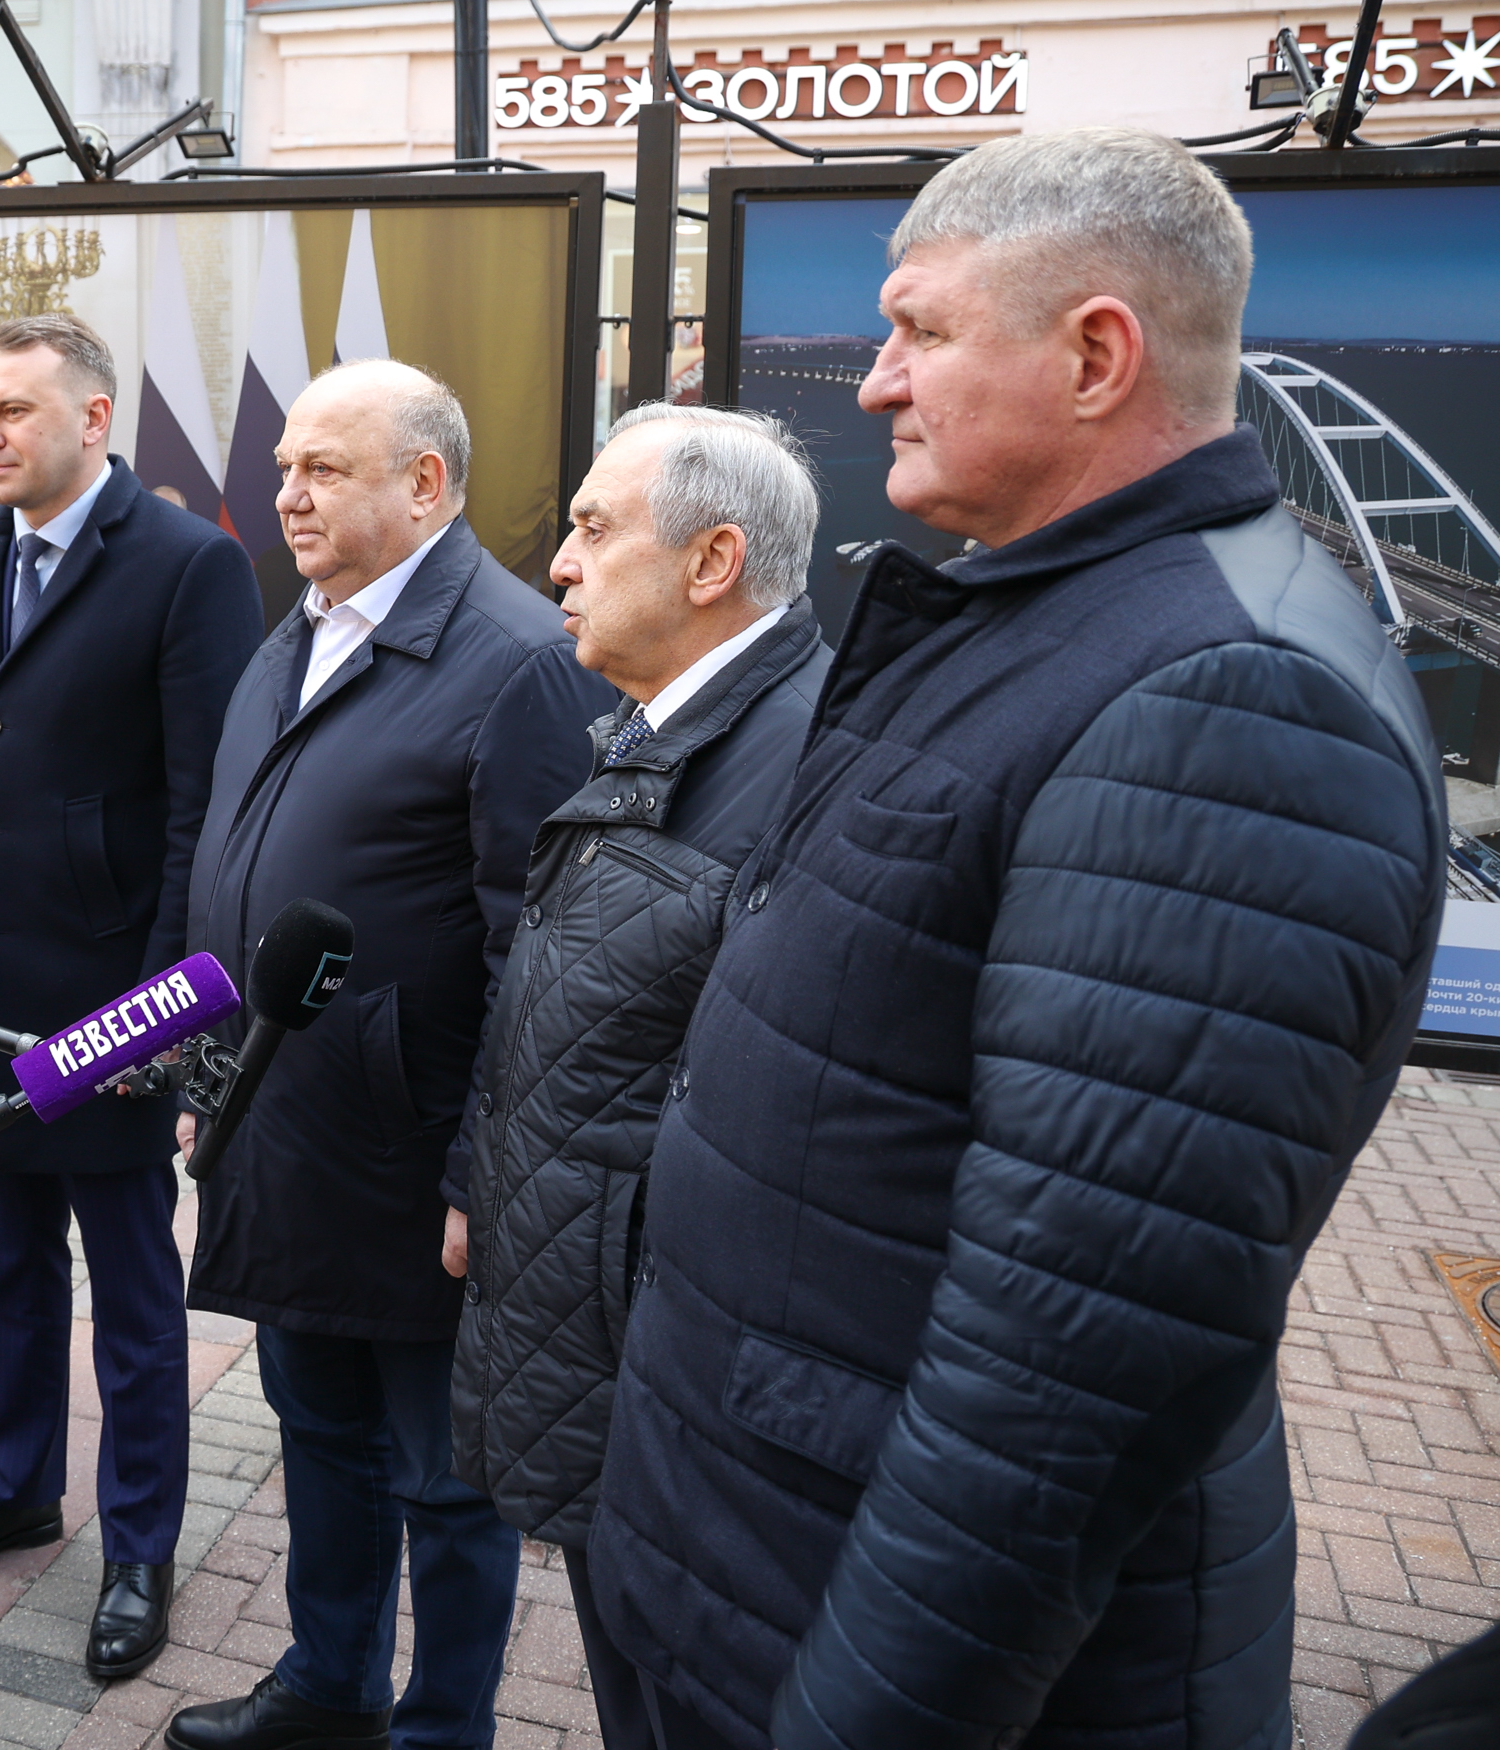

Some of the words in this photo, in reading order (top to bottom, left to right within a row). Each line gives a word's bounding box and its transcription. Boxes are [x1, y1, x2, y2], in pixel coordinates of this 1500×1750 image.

[494, 74, 607, 128] 585
[680, 52, 1029, 123] ЗОЛОТОЙ
[1428, 977, 1481, 990] тавший
[48, 970, 199, 1078] ИЗВЕСТИЯ
